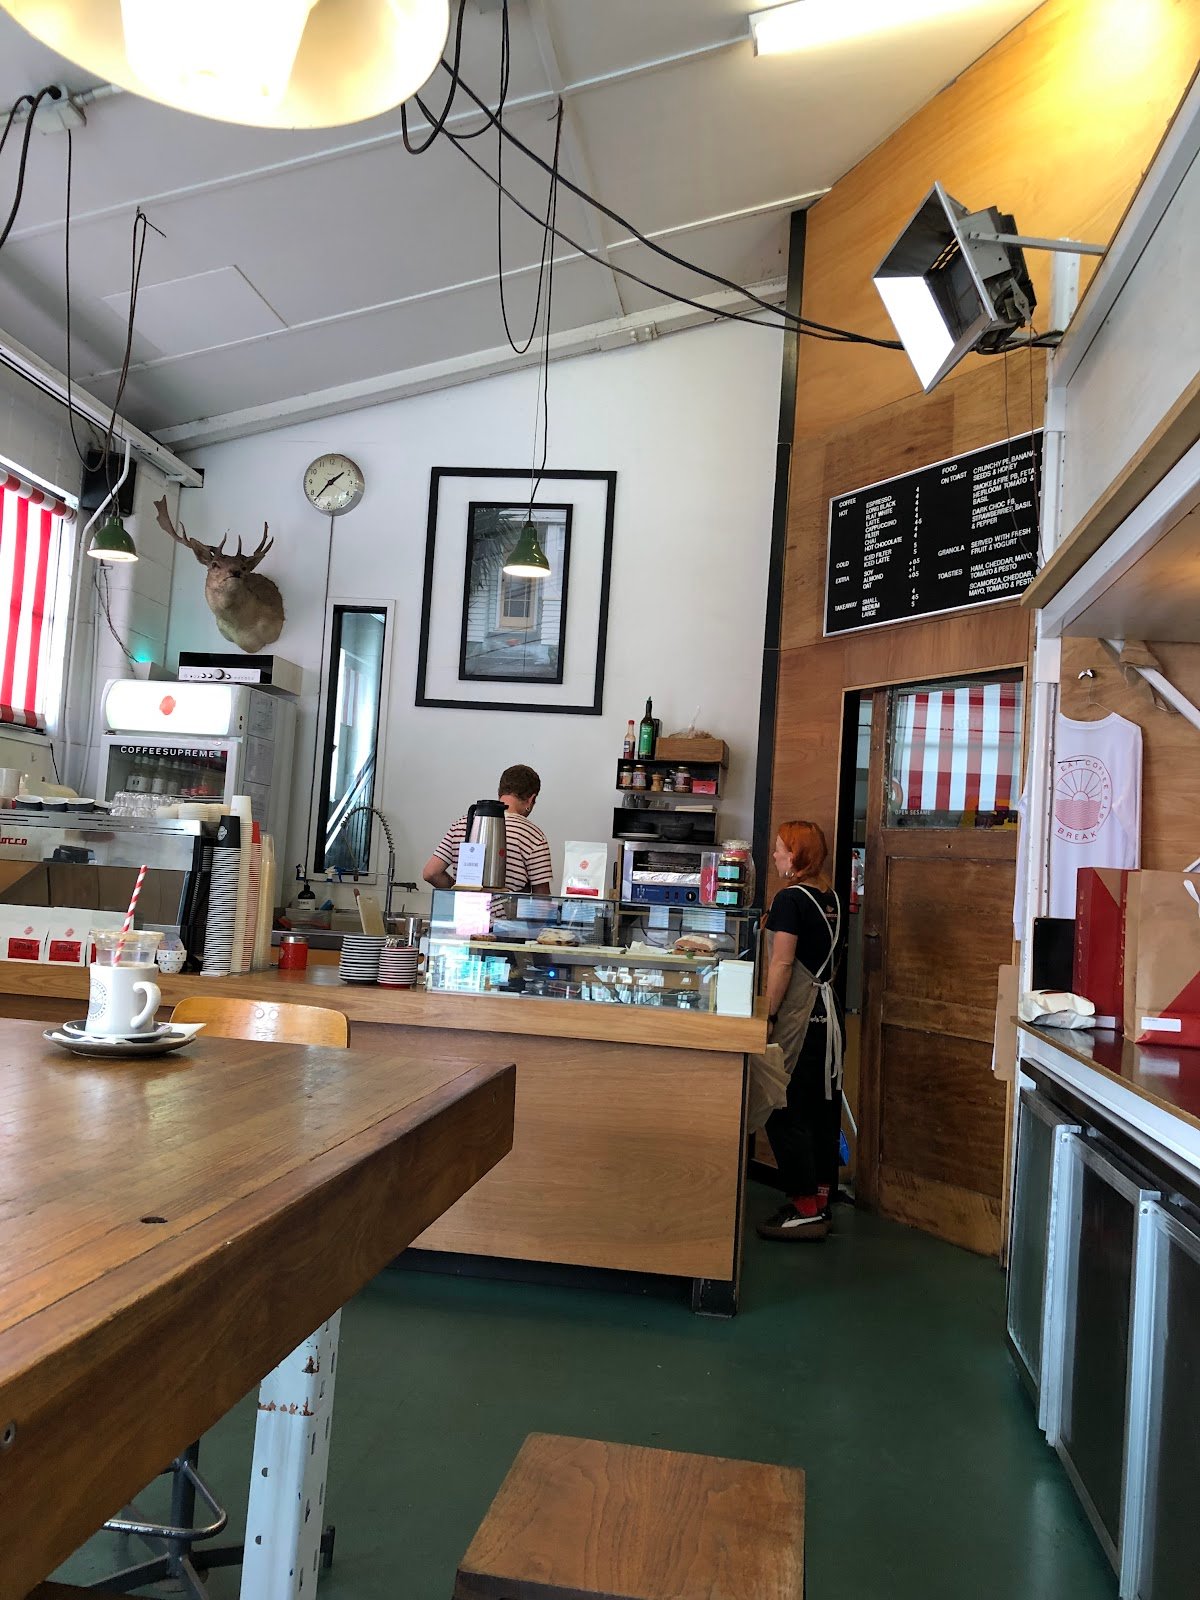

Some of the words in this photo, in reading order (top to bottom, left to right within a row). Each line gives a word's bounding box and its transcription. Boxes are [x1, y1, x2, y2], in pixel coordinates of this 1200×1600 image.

[942, 465, 958, 474] FOOD
[973, 460, 1001, 474] CRUNCHY
[973, 470, 991, 481] SEEDS
[992, 468, 996, 476] &
[997, 462, 1018, 473] HONEY
[941, 477, 949, 485] ON
[950, 471, 967, 481] TOAST
[973, 480, 992, 491] SMOKE
[993, 478, 997, 486] &
[997, 475, 1008, 485] FIRE
[973, 484, 1002, 499] HEIRLOOM
[1004, 477, 1028, 489] TOMATO
[839, 498, 856, 508] COFFEE
[866, 496, 892, 508] ESPRESSO
[973, 495, 989, 505] BASIL
[1015, 501, 1032, 511] BASIL
[839, 509, 848, 517] HOT
[866, 506, 879, 514] LONG
[880, 500, 896, 510] BLACK
[972, 505, 988, 516] DARK
[989, 501, 1005, 511] CHOC
[866, 512, 877, 520] FLAT
[878, 508, 893, 517] WHITE
[865, 519, 897, 533] CAPPUCCINO
[866, 518, 880, 527] LATTE
[976, 517, 998, 528] PEPPER
[865, 530, 880, 539] FILTER
[971, 537, 993, 548] SERVED
[995, 532, 1010, 542] WITH
[1011, 527, 1031, 538] FRESH
[865, 544, 874, 552] HOT
[874, 536, 902, 549] CHOCOLATE
[971, 545, 988, 555] FRUIT
[988, 543, 992, 551] &
[993, 538, 1017, 549] YOGURT
[864, 553, 875, 561] ICED
[876, 549, 892, 558] FILTER
[938, 545, 965, 557] GRANOLA
[864, 560, 875, 568] ICED
[876, 556, 890, 564] LATTE
[864, 569, 874, 577] SOY
[938, 569, 962, 579] TOASTIES
[970, 569, 993, 579] TOMATO
[998, 563, 1017, 573] PESTO
[835, 576, 850, 584] EXTRA
[863, 573, 884, 583] ALMOND
[969, 588, 985, 597] MAYO,
[986, 582, 1009, 593] TOMATO
[1010, 580, 1014, 588] &
[1016, 577, 1034, 587] PESTO
[835, 601, 857, 611] TAKEAWAY
[862, 597, 878, 605] SMALL
[862, 602, 880, 611] MEDIUM
[862, 609, 876, 618] LARGE
